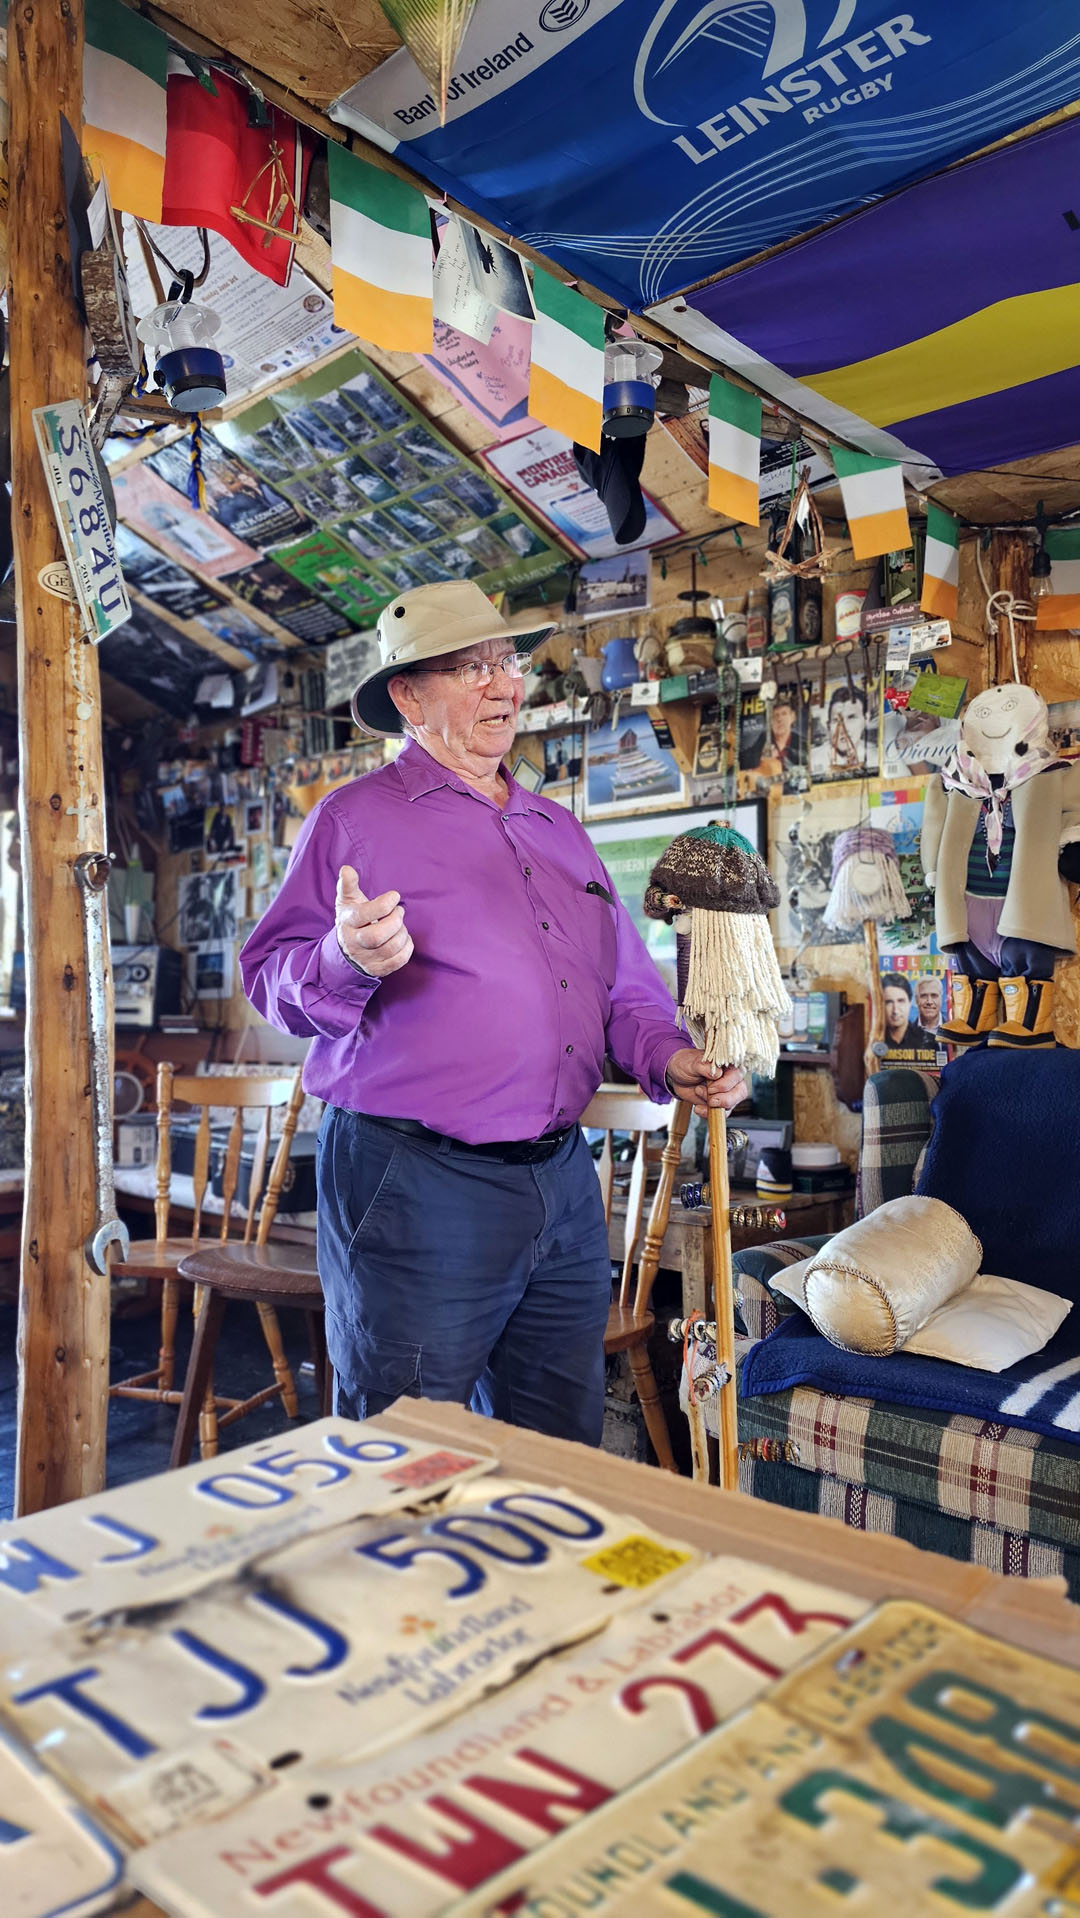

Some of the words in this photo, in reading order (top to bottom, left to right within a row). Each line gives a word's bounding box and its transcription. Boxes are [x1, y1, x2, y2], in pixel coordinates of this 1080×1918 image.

[446, 76, 467, 102] of
[460, 31, 536, 90] Ireland
[672, 14, 933, 165] LEINSTER
[801, 72, 894, 125] RUGBY
[52, 464, 63, 489] JUL
[59, 424, 122, 614] S684U
[93, 489, 117, 569] Manitoba
[80, 562, 93, 594] 2016
[884, 737, 959, 763] Diana
[918, 1048, 936, 1061] TIDE
[194, 1434, 410, 1510] 056
[12, 1589, 351, 1761] TJJ
[353, 1493, 606, 1600] 500
[218, 1684, 573, 1877] Newfoundland
[569, 1666, 609, 1696] &
[604, 1583, 750, 1677] Labrador
[252, 1747, 616, 1918] TWN
